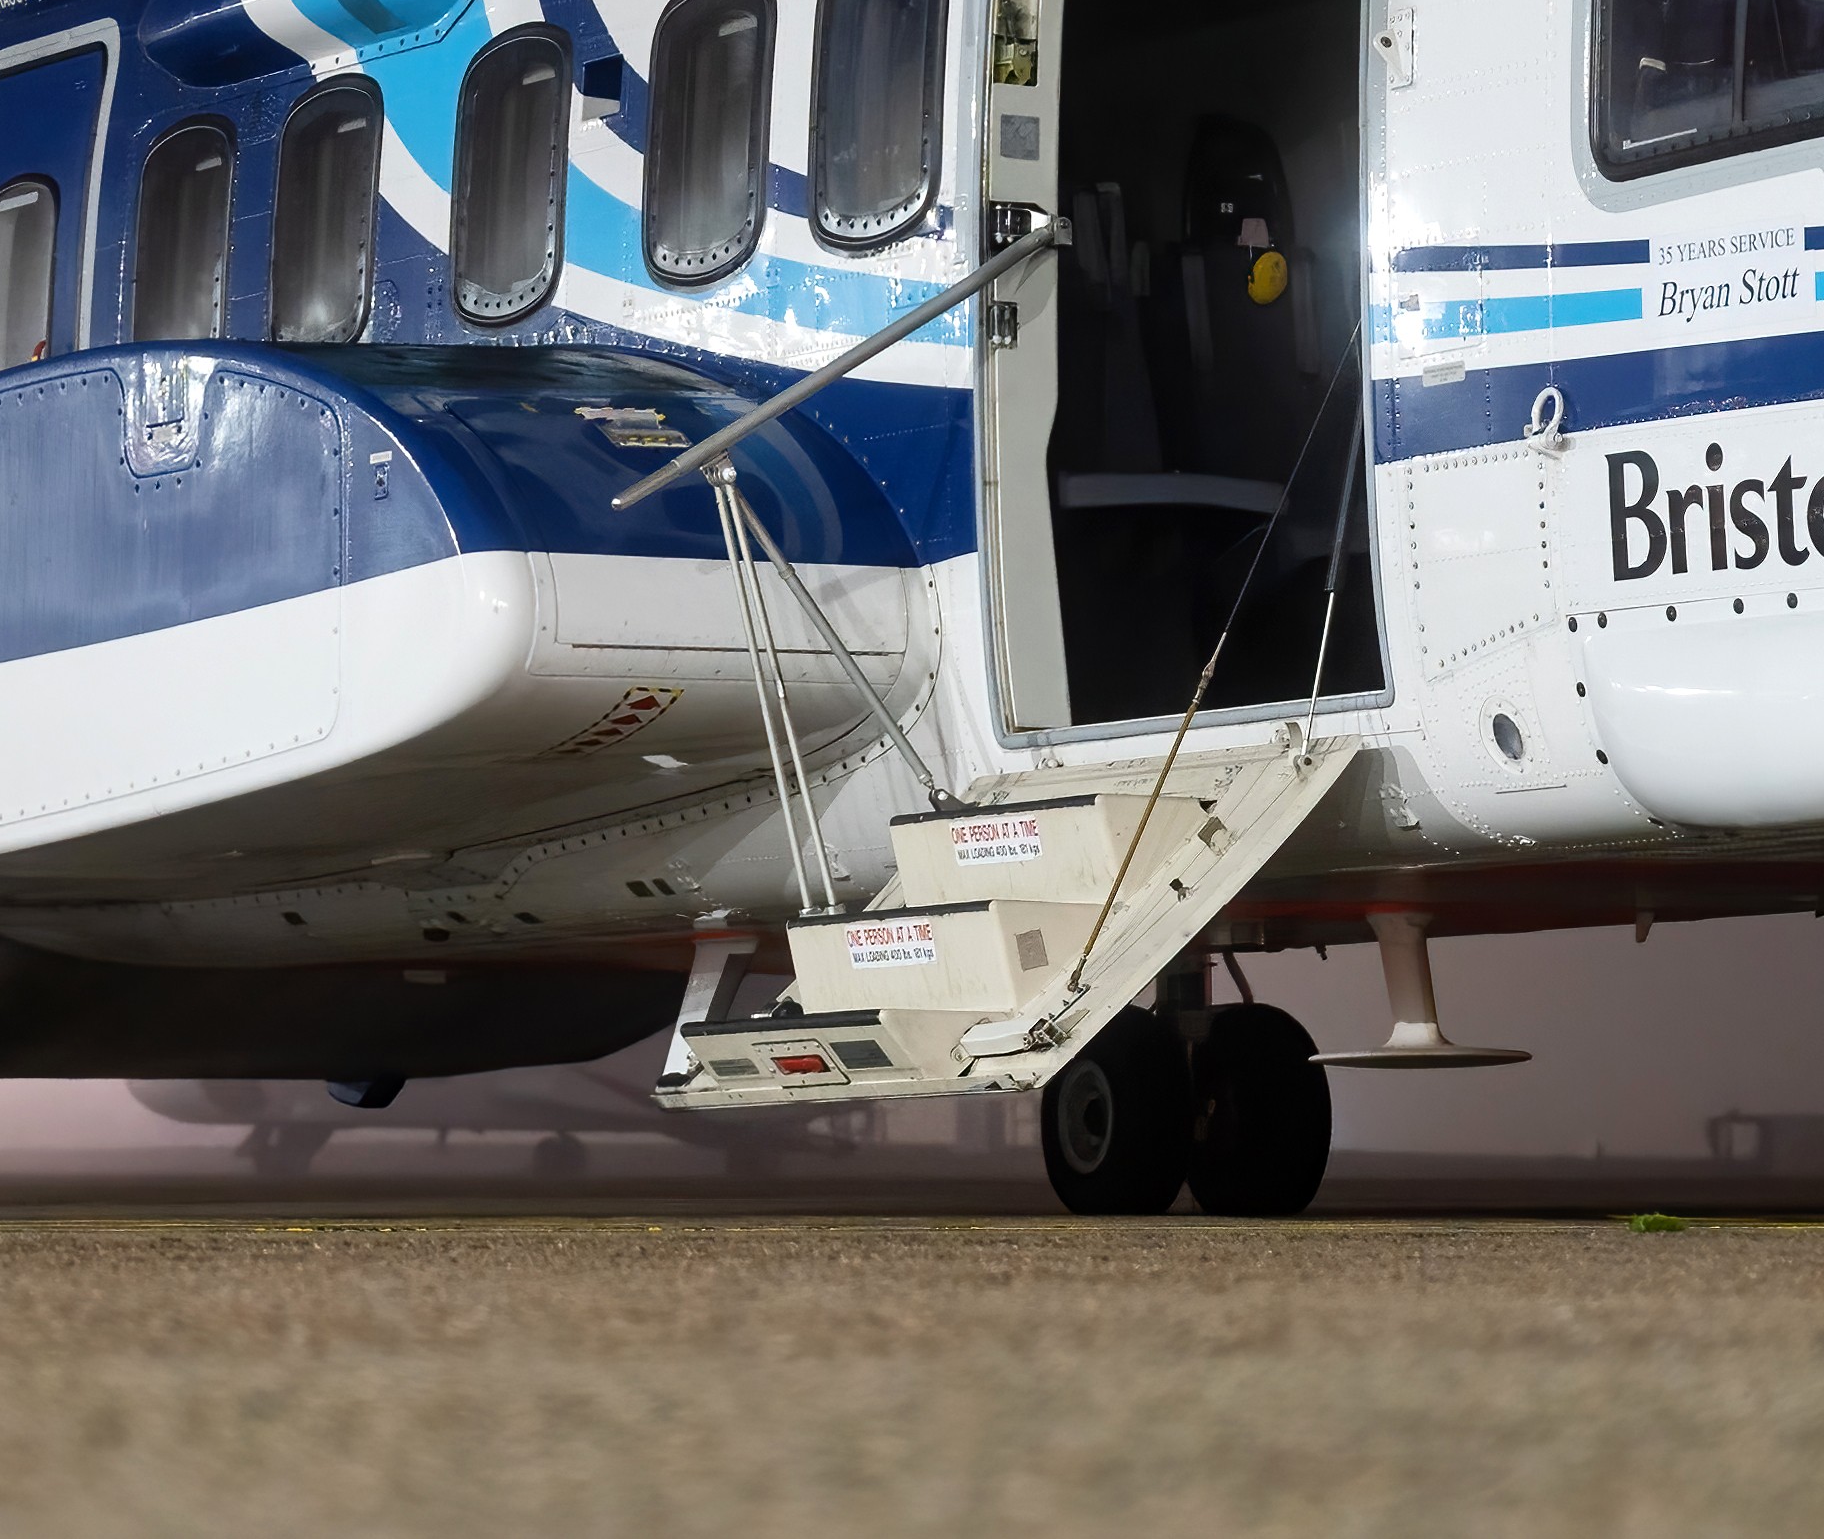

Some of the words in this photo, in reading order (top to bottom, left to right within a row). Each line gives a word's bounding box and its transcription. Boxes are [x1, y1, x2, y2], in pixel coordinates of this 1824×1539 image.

[1658, 246, 1673, 266] 35
[1676, 238, 1726, 262] YEARS
[1730, 227, 1796, 254] SERVICE
[1658, 281, 1731, 323] Bryan
[1738, 267, 1800, 305] Stott
[951, 826, 969, 844] ONE
[969, 823, 1001, 842] PERSON
[1002, 822, 1010, 839] AT
[1013, 822, 1020, 838] A
[1019, 819, 1039, 838] TIME
[970, 845, 995, 859] LOADING
[846, 929, 864, 947] ONE
[863, 927, 895, 946] PERSON
[896, 926, 904, 943] AT
[906, 926, 914, 942] A
[913, 923, 933, 941] TIME
[865, 950, 890, 963] LOADING
